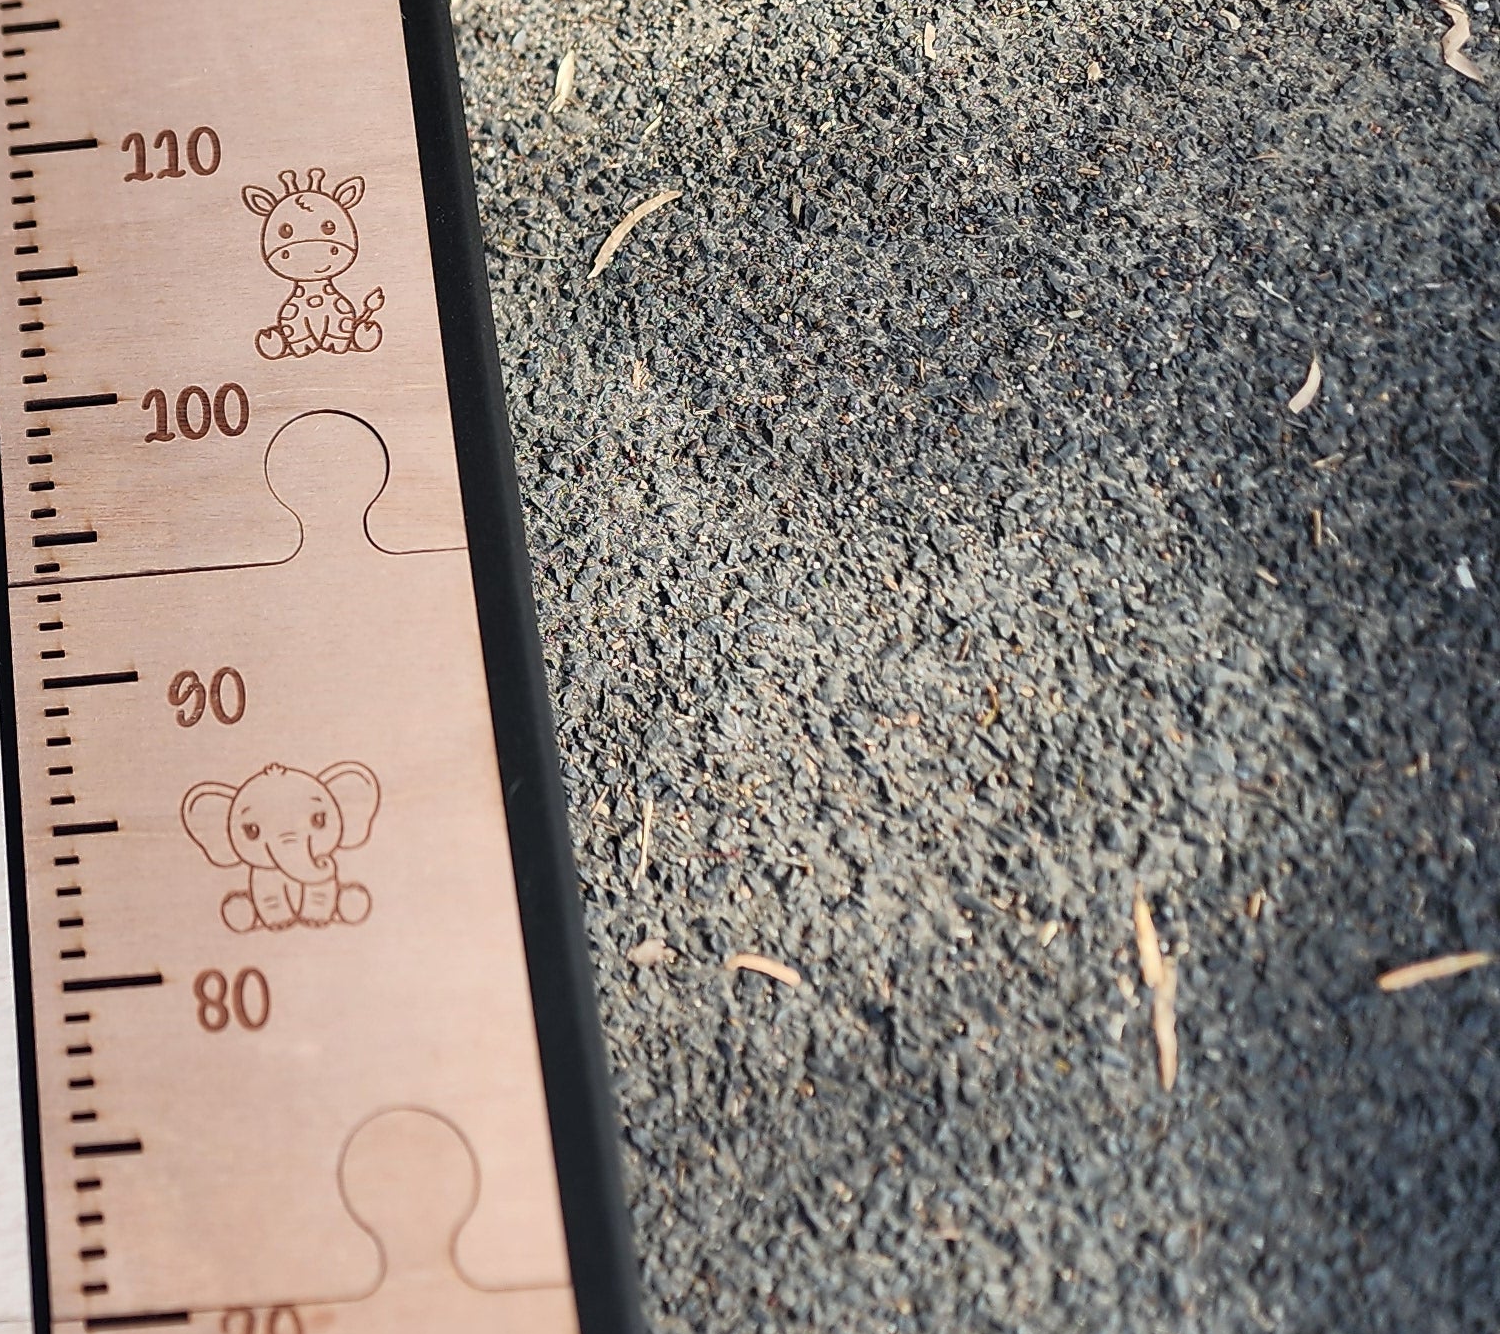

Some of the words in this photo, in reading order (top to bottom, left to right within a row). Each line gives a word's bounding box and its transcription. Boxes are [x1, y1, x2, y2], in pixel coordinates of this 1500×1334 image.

[121, 126, 221, 182] 110
[141, 382, 250, 443] 100
[167, 666, 246, 727] 90
[193, 967, 270, 1032] 80
